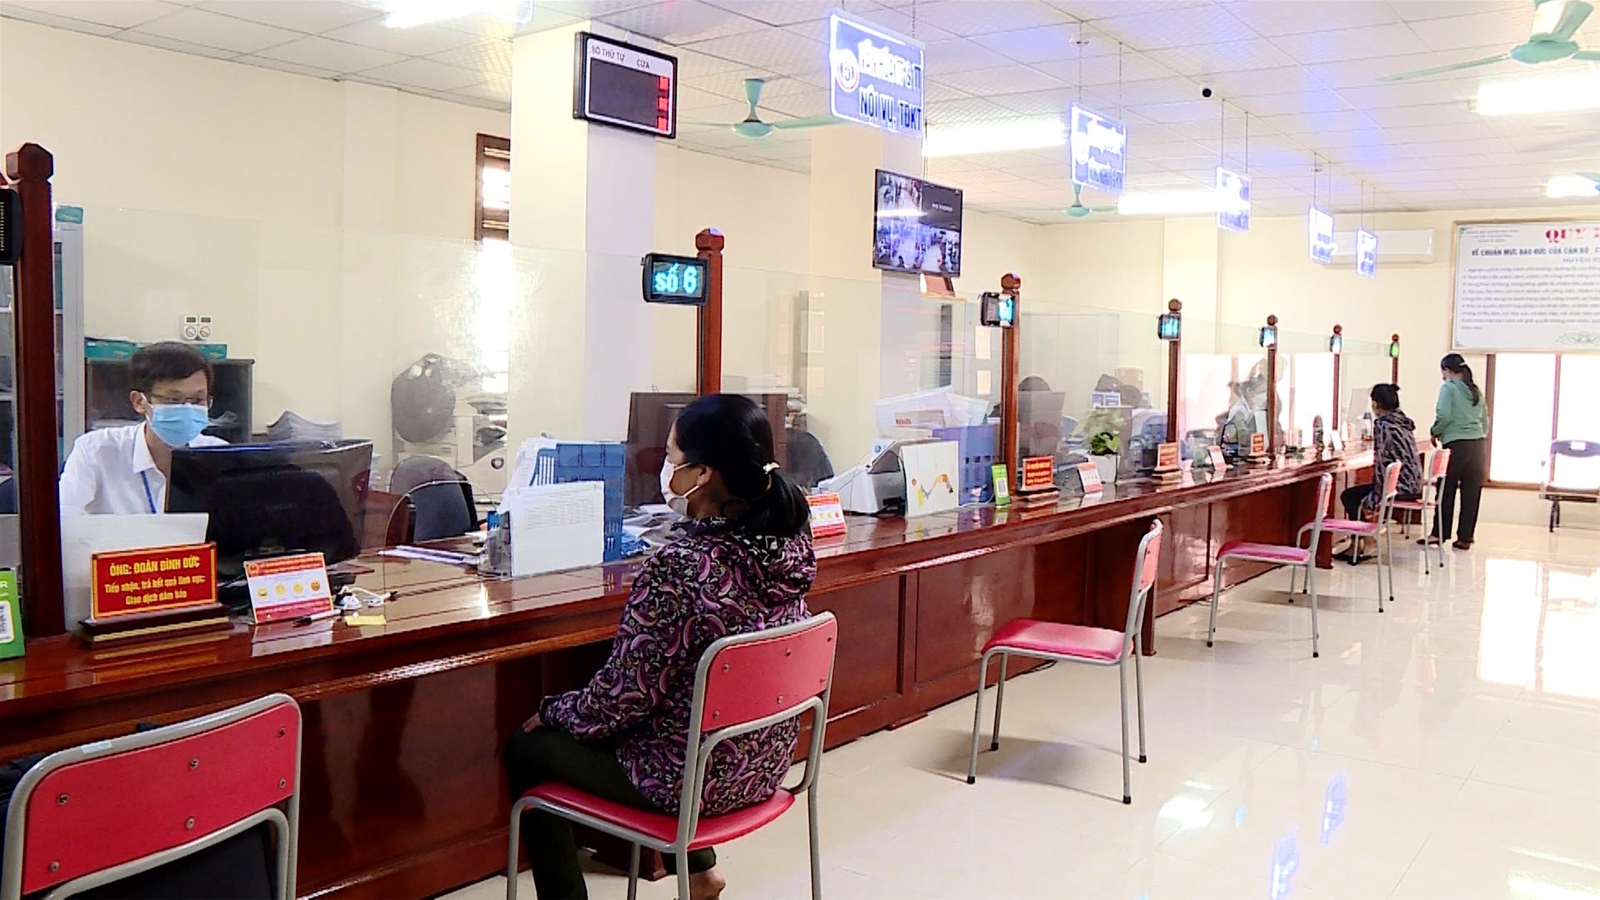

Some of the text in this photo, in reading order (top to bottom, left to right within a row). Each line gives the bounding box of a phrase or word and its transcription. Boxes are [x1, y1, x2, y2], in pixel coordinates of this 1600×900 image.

[683, 265, 699, 294] 6
[109, 554, 200, 577] ÔNG: ĐOÀN ĐÌNH ĐỨC
